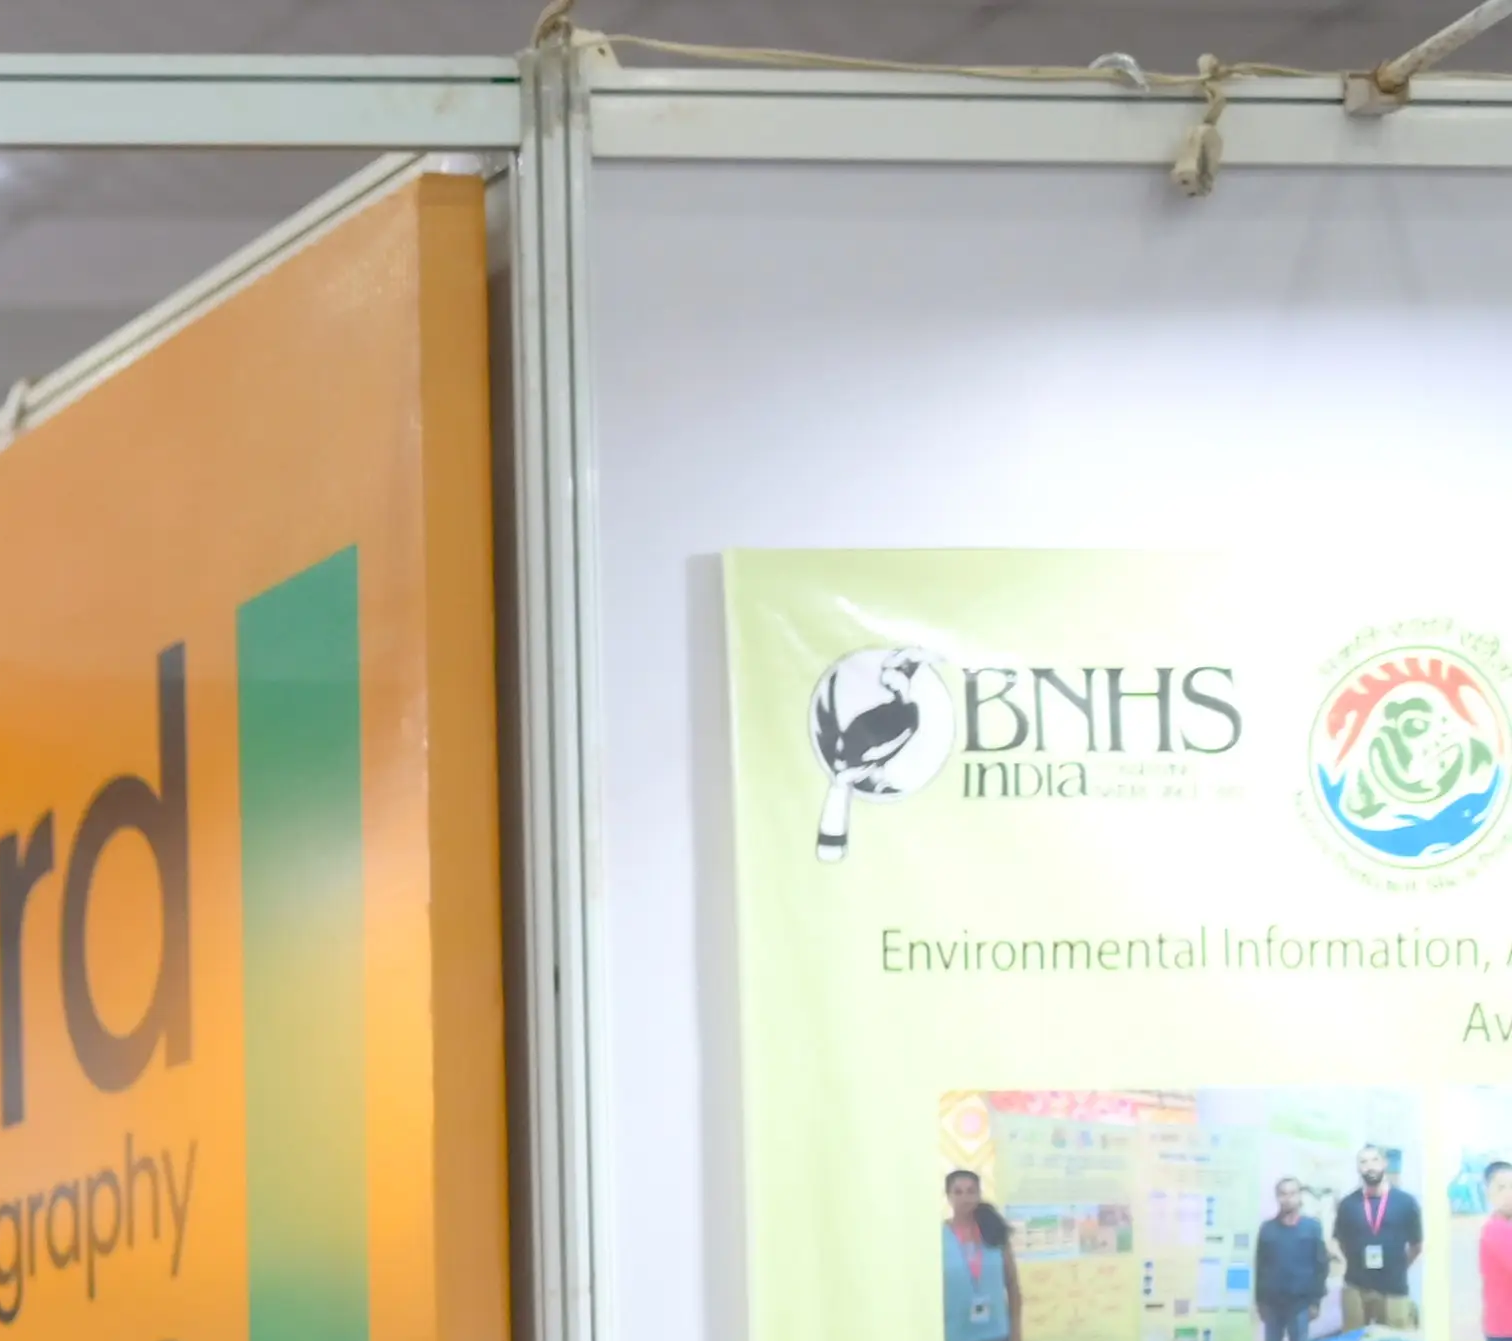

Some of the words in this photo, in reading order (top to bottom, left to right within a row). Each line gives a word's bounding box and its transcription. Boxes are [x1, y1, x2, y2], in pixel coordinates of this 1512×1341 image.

[961, 666, 1243, 754] BNHS
[881, 925, 1208, 974] Environmental
[1224, 924, 1492, 975] Information,
